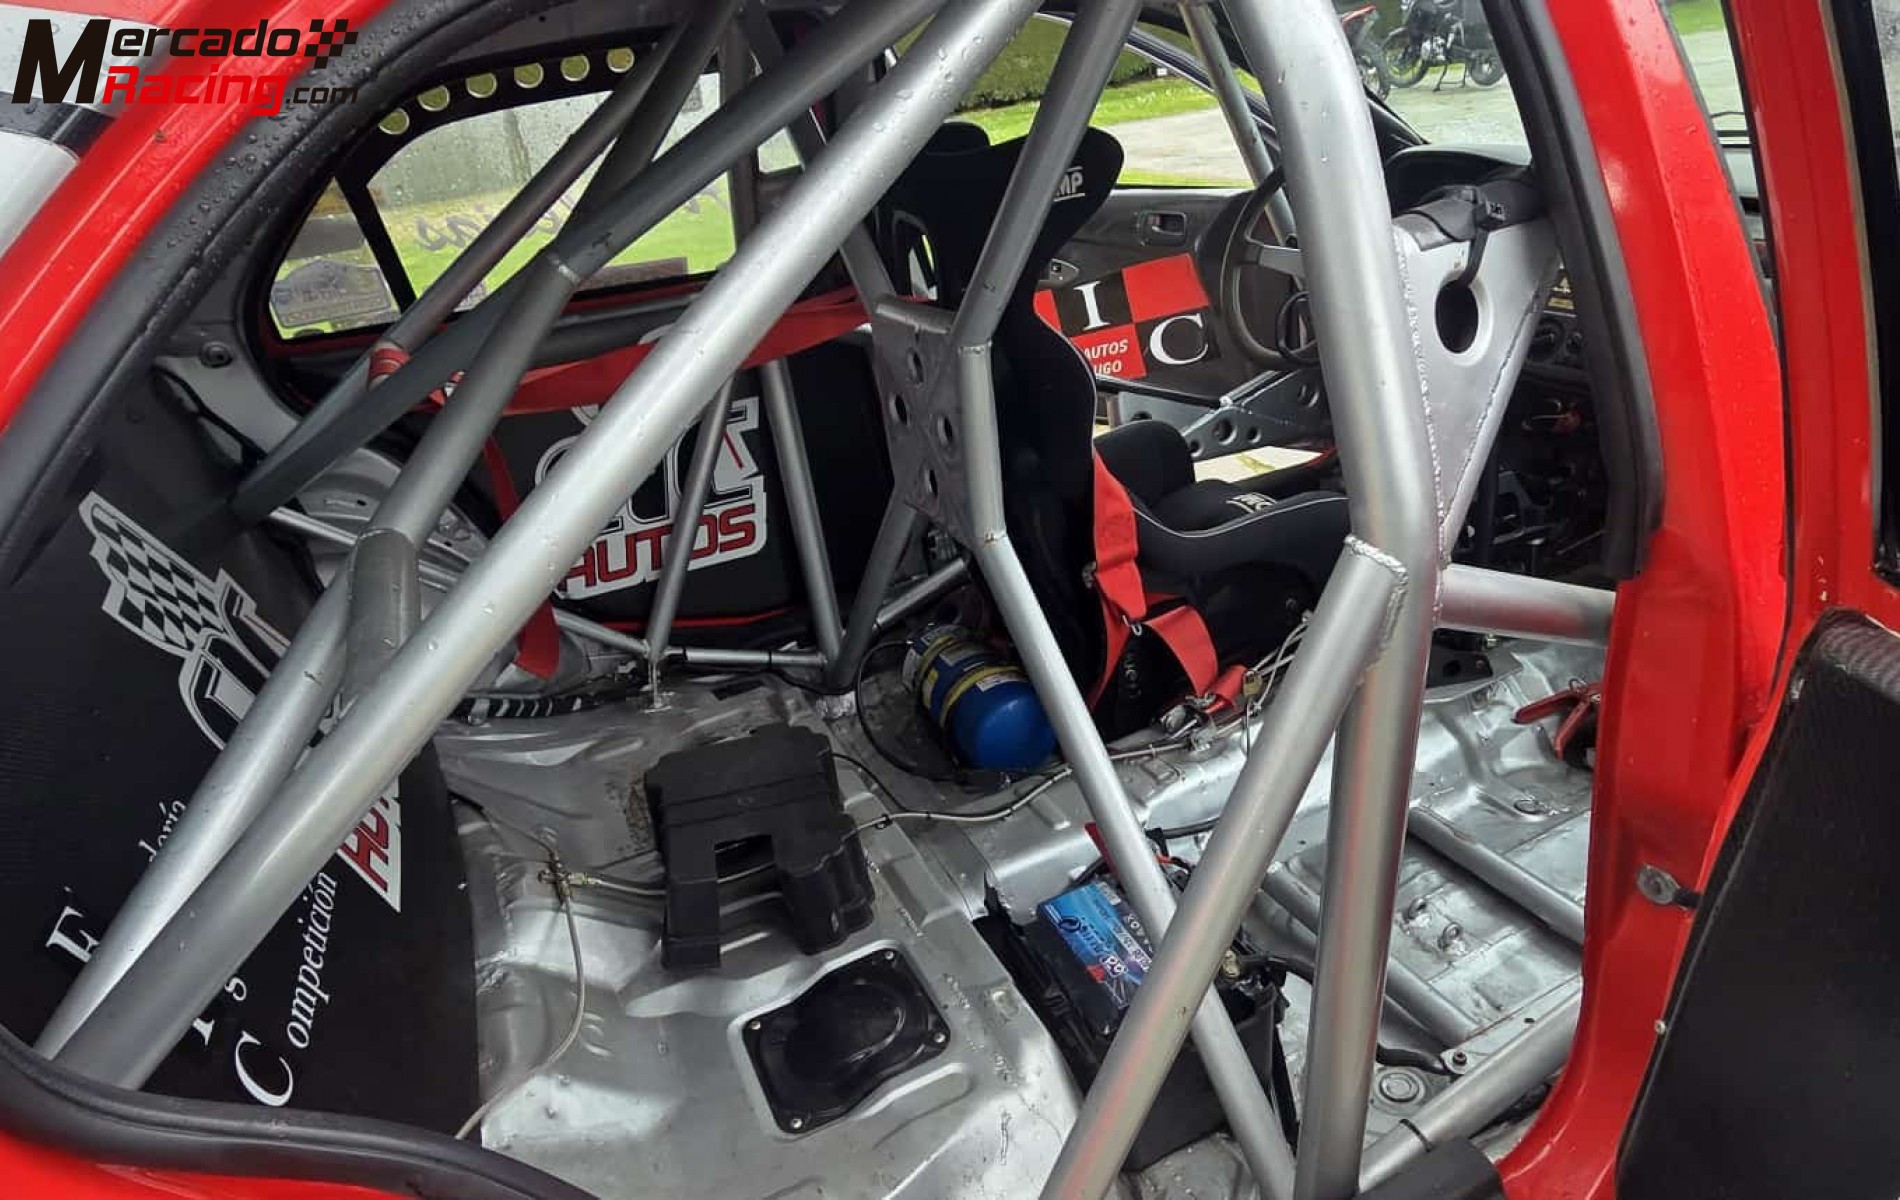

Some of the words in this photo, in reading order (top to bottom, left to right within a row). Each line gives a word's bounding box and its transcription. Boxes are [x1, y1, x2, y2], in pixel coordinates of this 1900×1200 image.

[1055, 171, 1083, 196] MP
[1073, 281, 1110, 331] I
[1150, 313, 1209, 365] C
[1093, 360, 1123, 375] UGO
